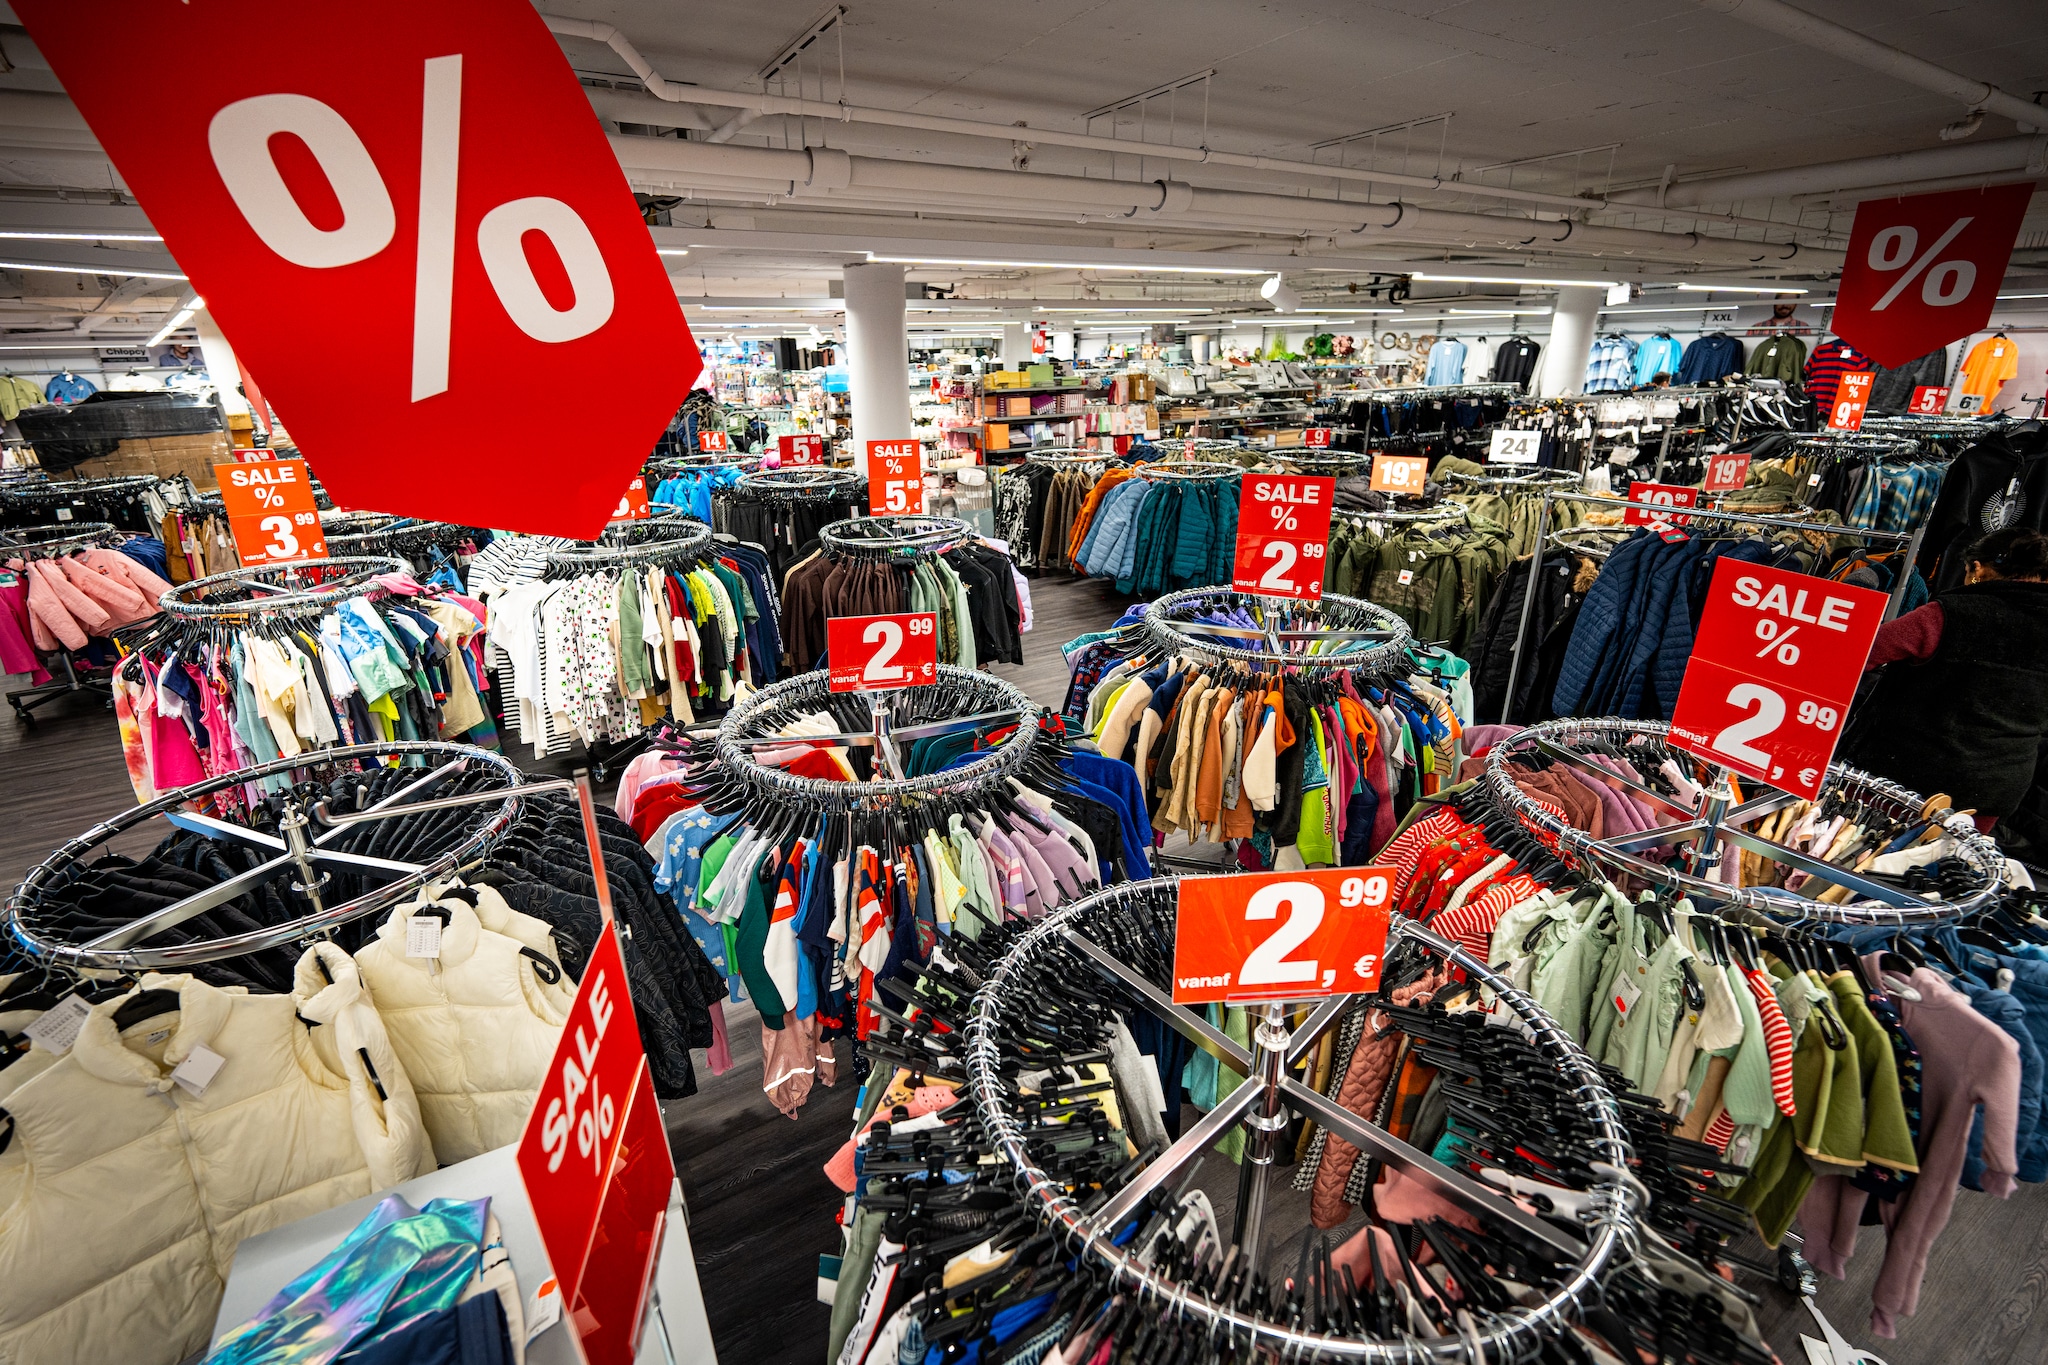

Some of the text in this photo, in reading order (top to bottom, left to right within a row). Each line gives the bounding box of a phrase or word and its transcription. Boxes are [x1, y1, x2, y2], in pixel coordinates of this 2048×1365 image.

[208, 53, 615, 403] %
[1867, 216, 1977, 312] %
[1712, 313, 1733, 322] XXL
[1844, 374, 1870, 386] SALE
[1848, 386, 1859, 398] %
[874, 444, 913, 458] SALE
[230, 466, 297, 487] SALE
[885, 458, 903, 475] %
[253, 485, 285, 508] %
[1253, 482, 1321, 505] SALE
[1270, 505, 1298, 531] %
[243, 552, 267, 561] vanaf
[1234, 579, 1257, 588] vanaf
[1731, 576, 1856, 633] SALE
[1755, 618, 1801, 666] %
[831, 674, 859, 683] vanaf
[1673, 726, 1709, 745] vanaf
[1178, 973, 1231, 988] vanaf
[541, 969, 614, 1174] SALE
[577, 1073, 615, 1176] %
